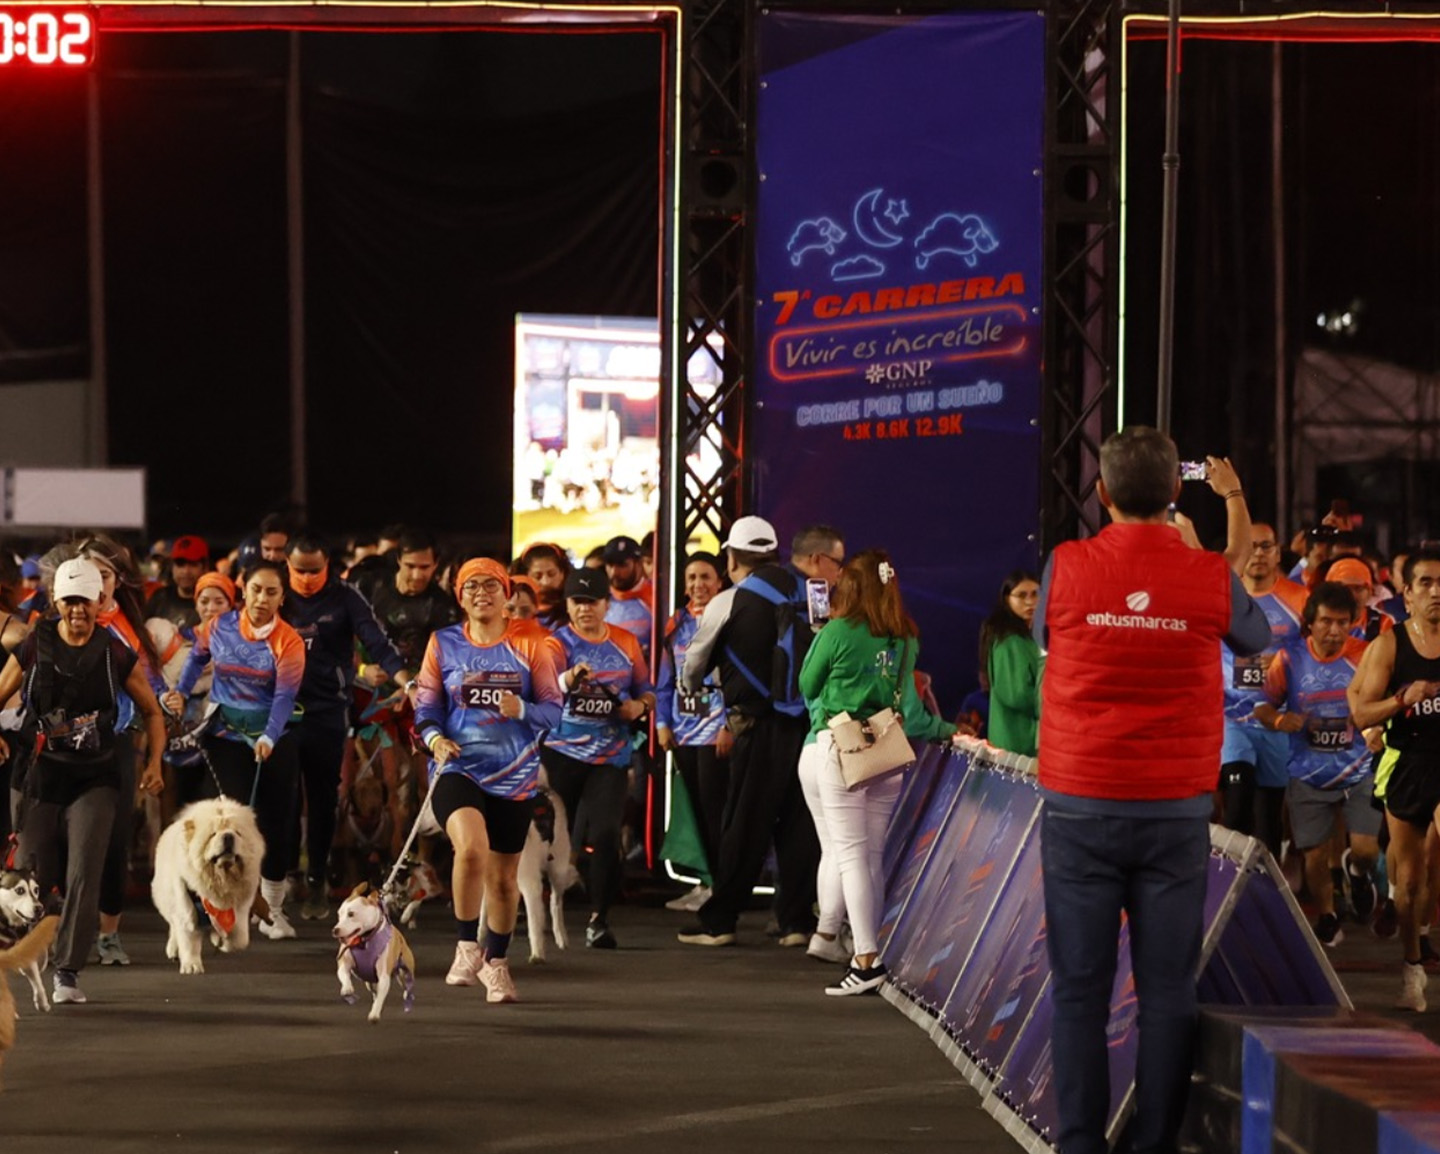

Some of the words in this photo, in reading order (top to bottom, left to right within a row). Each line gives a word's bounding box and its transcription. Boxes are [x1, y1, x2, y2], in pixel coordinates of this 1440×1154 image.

[813, 272, 1026, 319] CARRERA
[785, 337, 847, 368] Vivir
[853, 339, 877, 359] es
[885, 316, 1004, 356] increíble
[886, 360, 933, 381] GNP
[796, 398, 861, 427] CORRE
[863, 393, 903, 418] POR
[906, 389, 935, 413] UN
[915, 413, 964, 438] 12.9K
[1086, 611, 1188, 632] entusmarcas
[469, 688, 514, 705] 250
[575, 698, 613, 715] 2020
[684, 697, 696, 711] 11
[1312, 731, 1348, 746] 3078
